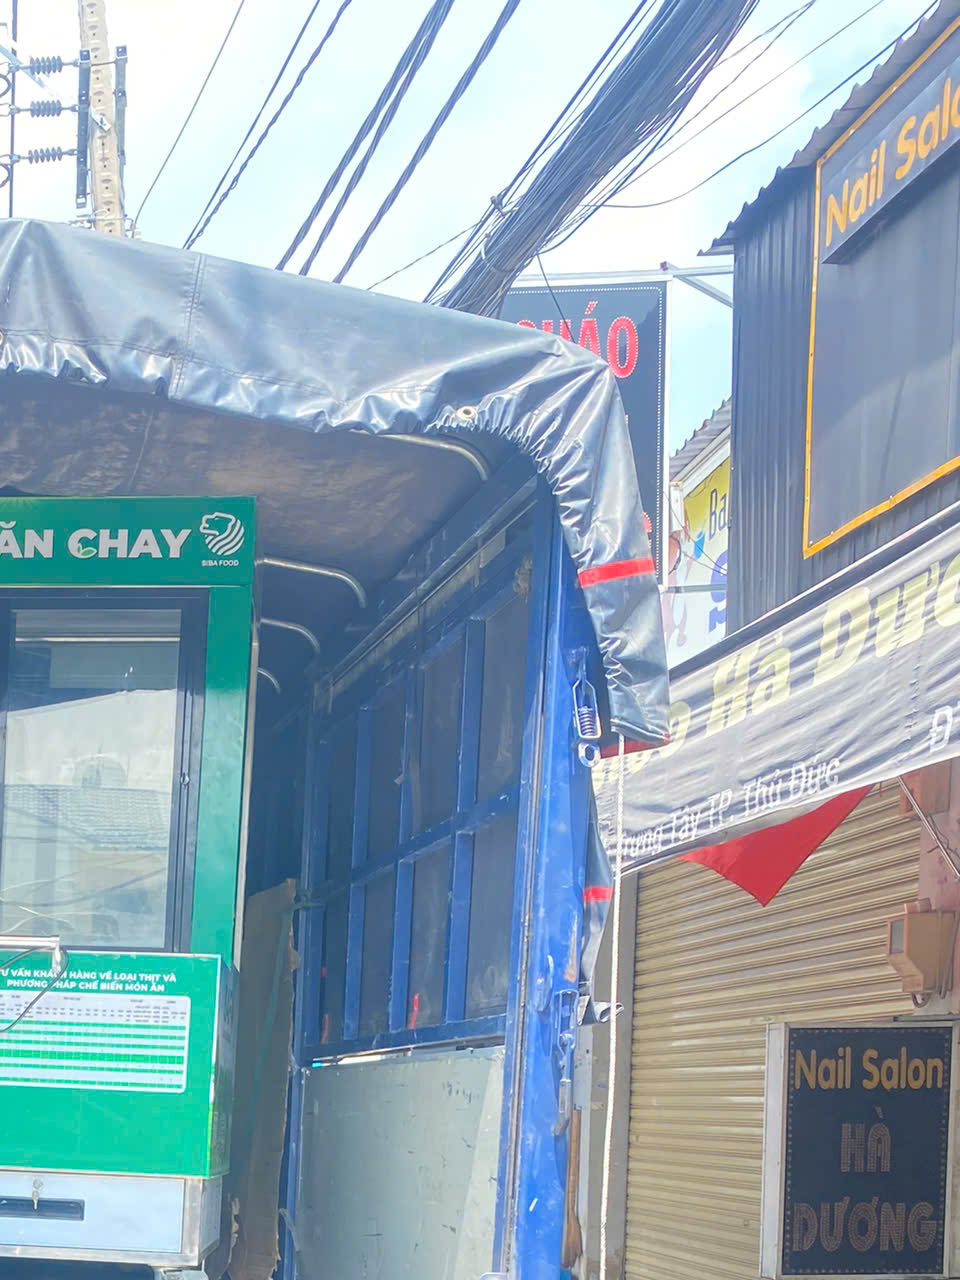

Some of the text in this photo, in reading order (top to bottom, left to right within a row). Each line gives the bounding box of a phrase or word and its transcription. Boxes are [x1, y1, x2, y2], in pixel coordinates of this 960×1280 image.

[825, 139, 887, 247] Nail
[67, 528, 192, 559] CHAY
[218, 559, 240, 567] FOOD
[6, 978, 48, 989] PHƯƠNG
[78, 977, 98, 991] CHẾ
[99, 978, 123, 992] BIẾN
[124, 980, 148, 992] MÓN
[149, 980, 166, 992] ĂN
[10, 967, 32, 978] VẤN
[69, 969, 97, 980] HÀNG
[98, 968, 113, 981] VỀ
[114, 971, 137, 983] LOẠI
[138, 972, 162, 984] THỊT
[162, 971, 177, 983] VÀ
[794, 1046, 944, 1090] Nail Salon
[840, 1106, 892, 1173] HÀ
[791, 1196, 938, 1252] DƯƠNG
